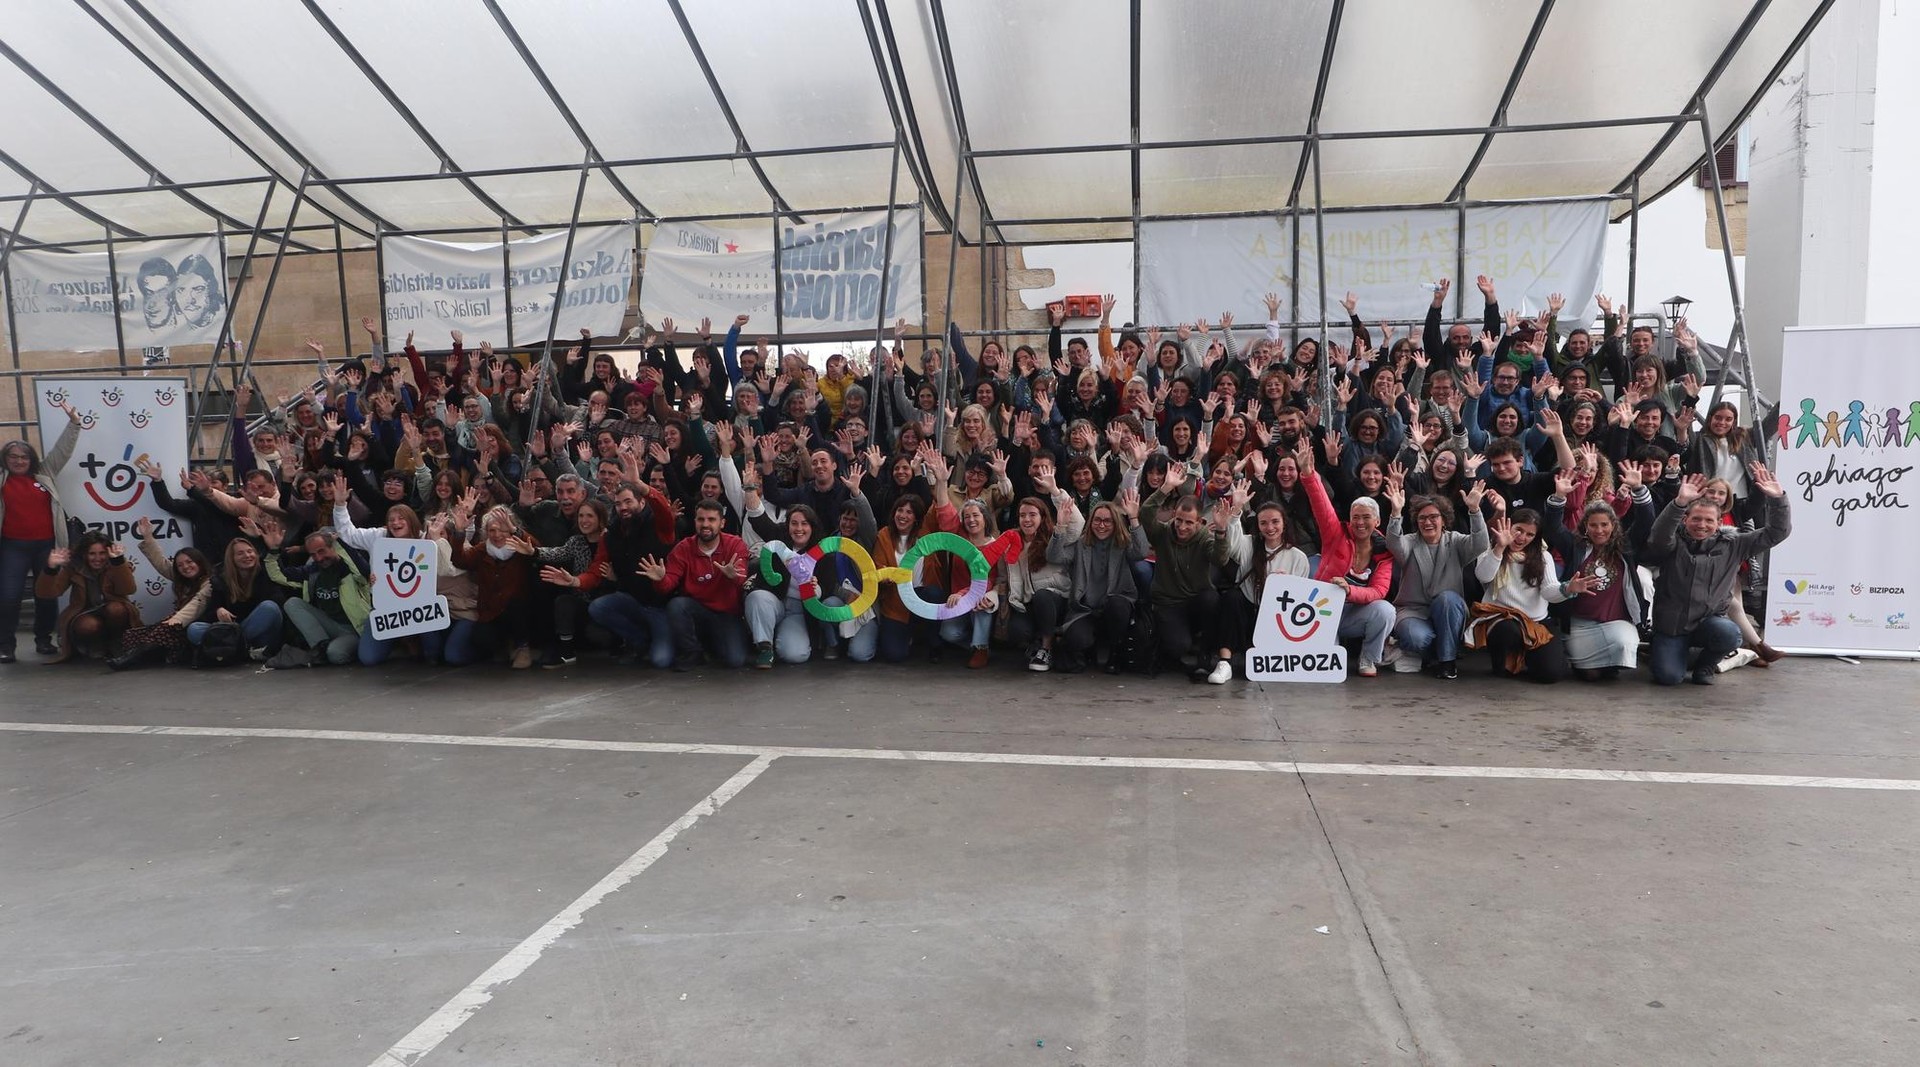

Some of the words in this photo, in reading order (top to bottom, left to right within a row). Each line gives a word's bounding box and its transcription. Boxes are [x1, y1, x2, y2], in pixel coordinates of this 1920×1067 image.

[1796, 453, 1914, 502] gehiago
[1831, 491, 1910, 527] gara
[1869, 586, 1905, 594] BIZIPOZA
[374, 602, 445, 632] BIZIPOZA
[1252, 653, 1343, 673] BIZIPOZA
